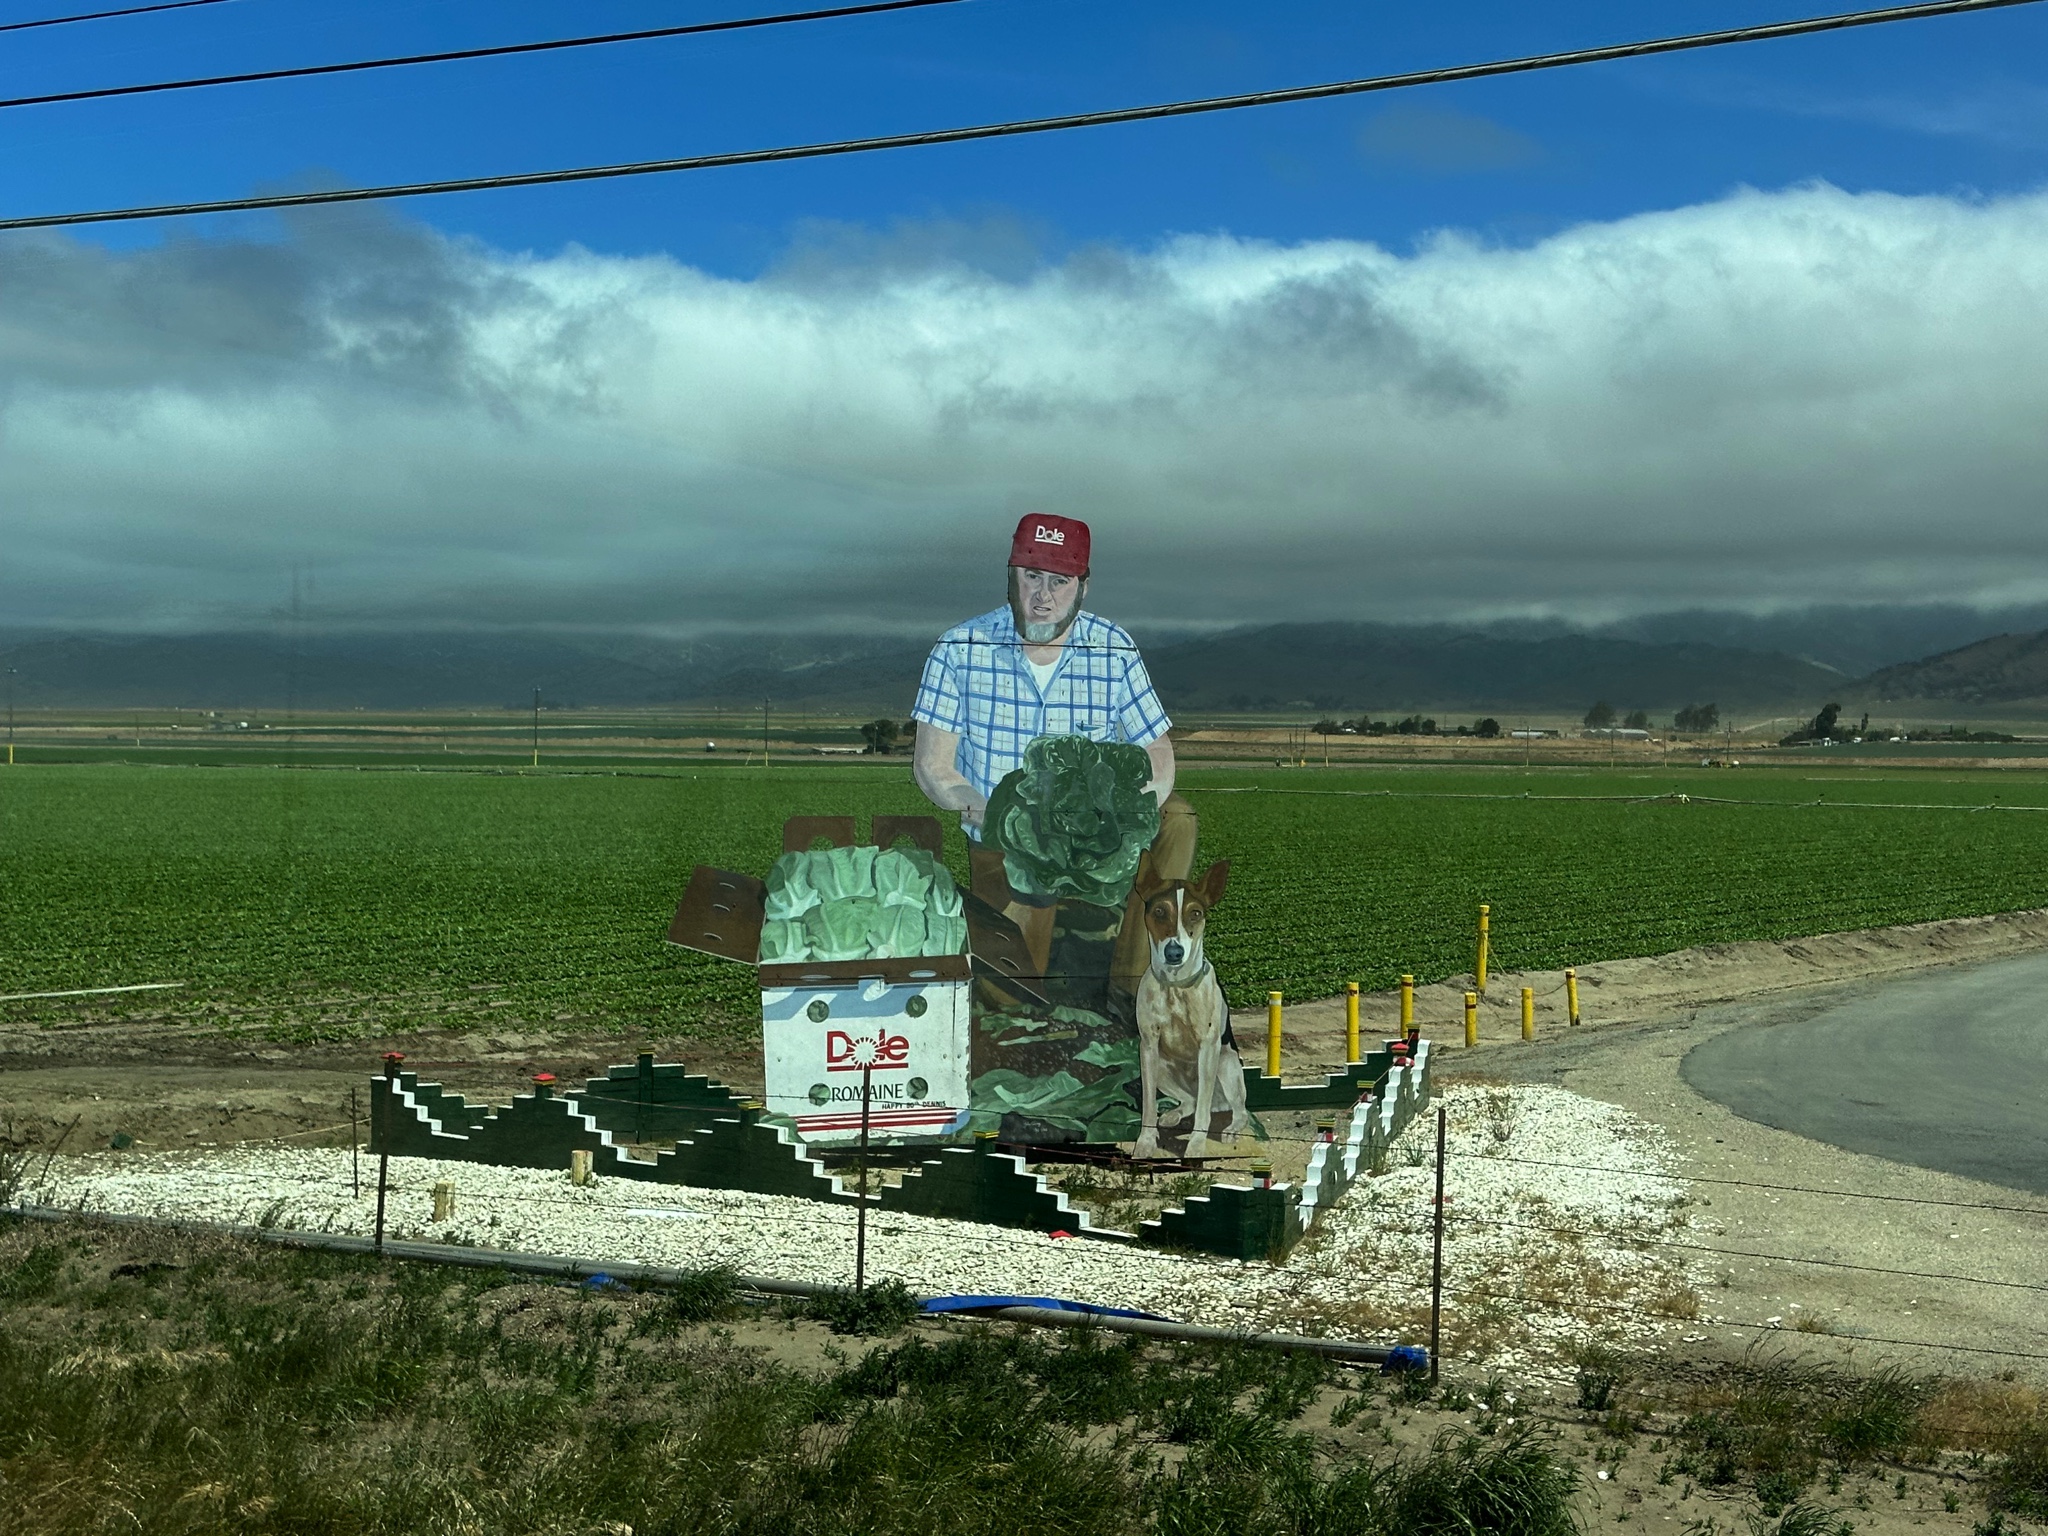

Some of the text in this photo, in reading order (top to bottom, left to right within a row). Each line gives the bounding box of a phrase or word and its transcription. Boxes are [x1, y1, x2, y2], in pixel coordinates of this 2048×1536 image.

[1035, 525, 1065, 542] Dole
[827, 1029, 909, 1063] Dole
[831, 1083, 903, 1102] ROMAINE
